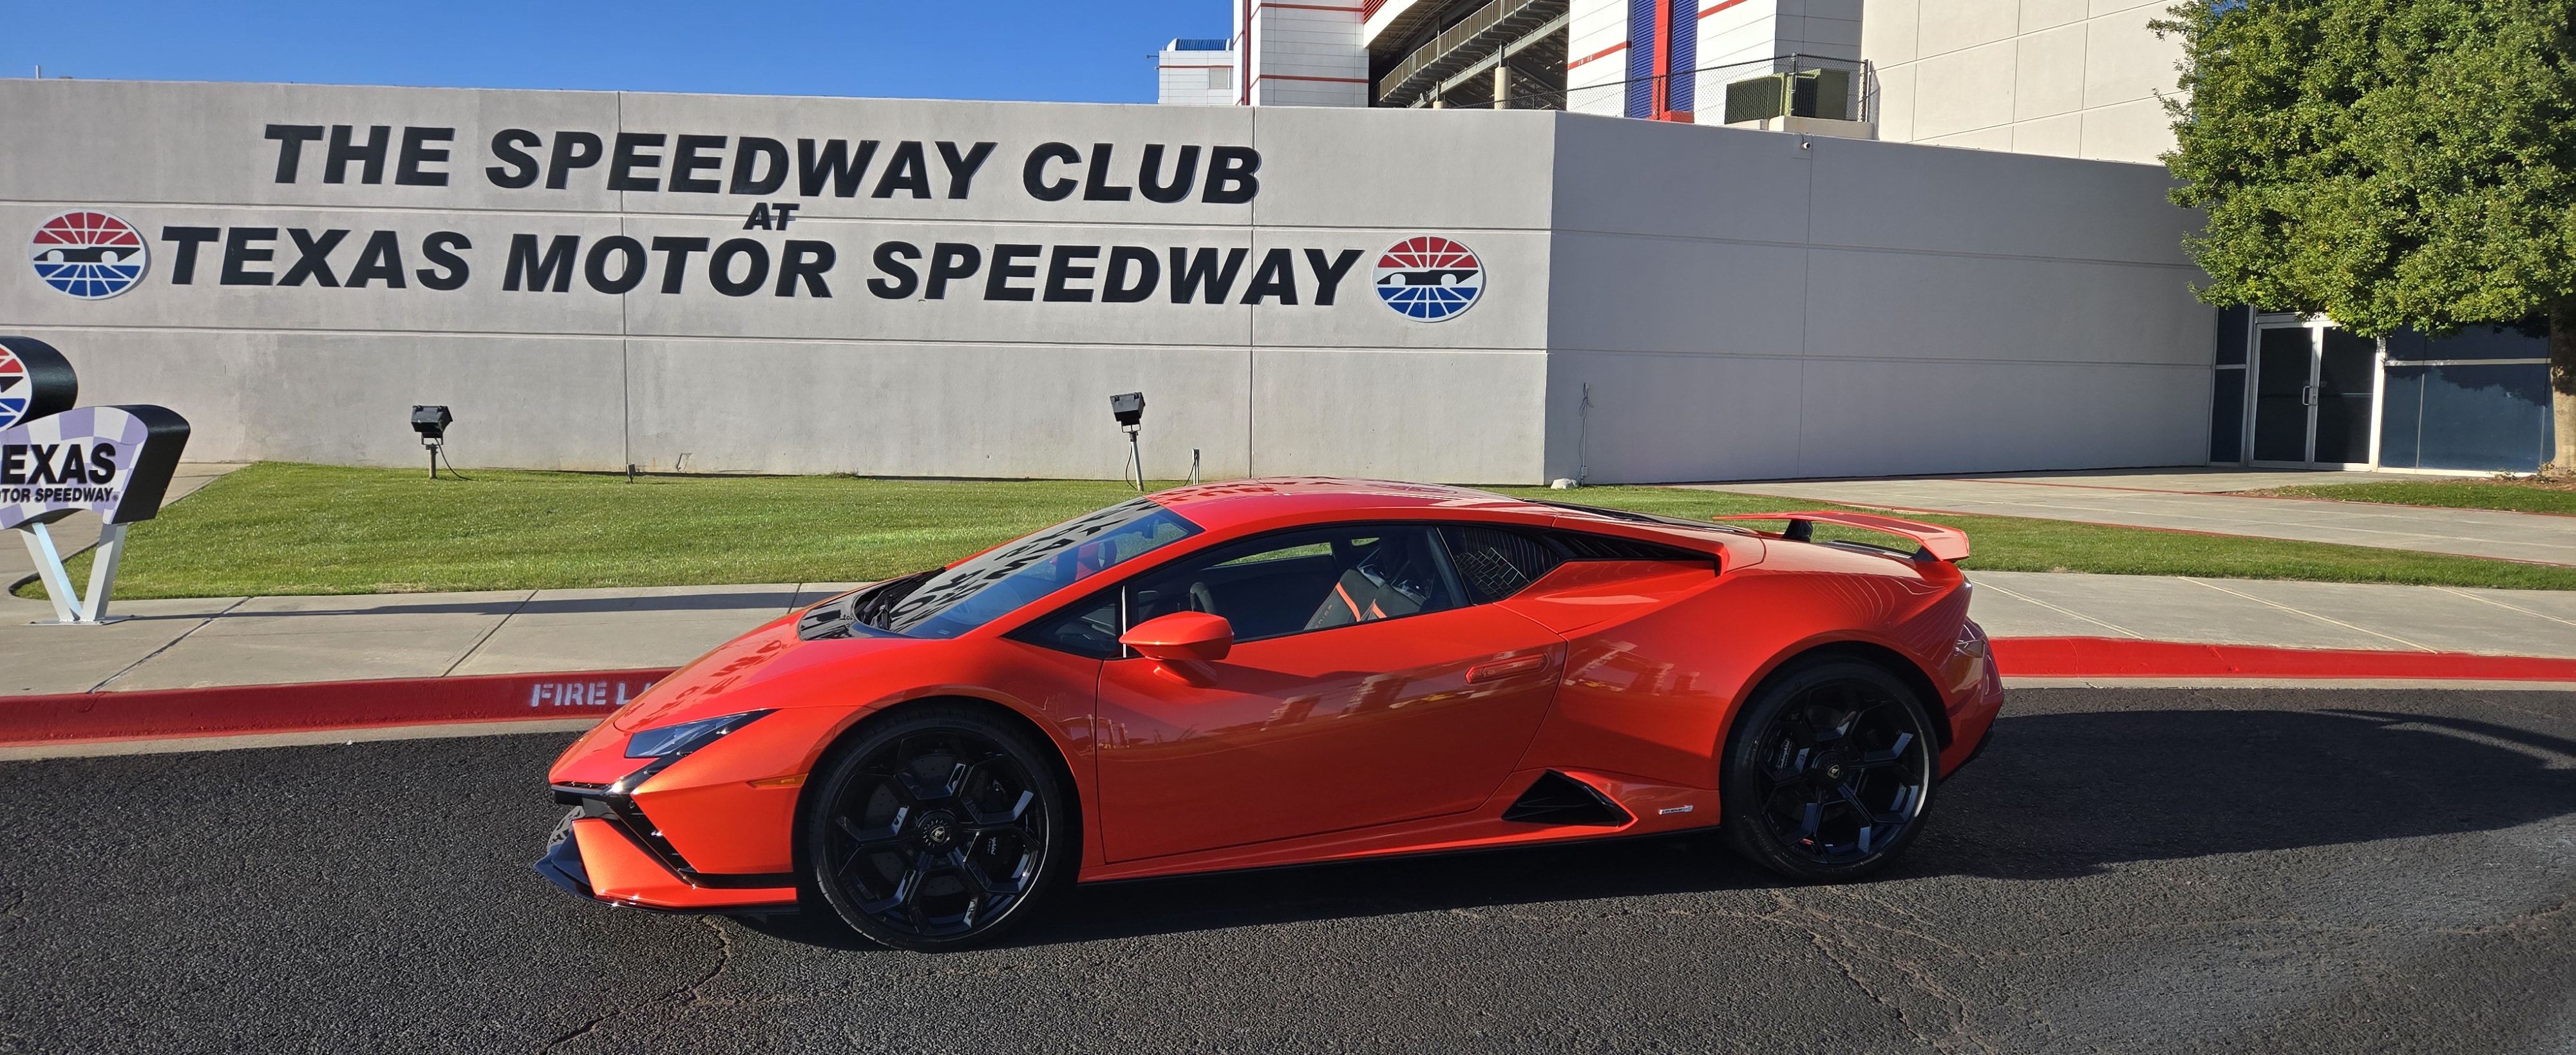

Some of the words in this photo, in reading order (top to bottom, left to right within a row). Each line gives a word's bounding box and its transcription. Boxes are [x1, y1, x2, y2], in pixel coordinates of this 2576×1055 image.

[265, 124, 455, 186] THE
[485, 128, 998, 200] SPEEDWAY
[1023, 142, 1262, 204] CLUB
[742, 202, 800, 231] AT
[161, 225, 471, 291] TEXAS
[502, 233, 836, 298] MOTOR
[866, 241, 1365, 306] SPEEDWAY
[0, 488, 31, 502] TOR
[531, 682, 607, 707] FIRE
[616, 681, 652, 706] L
